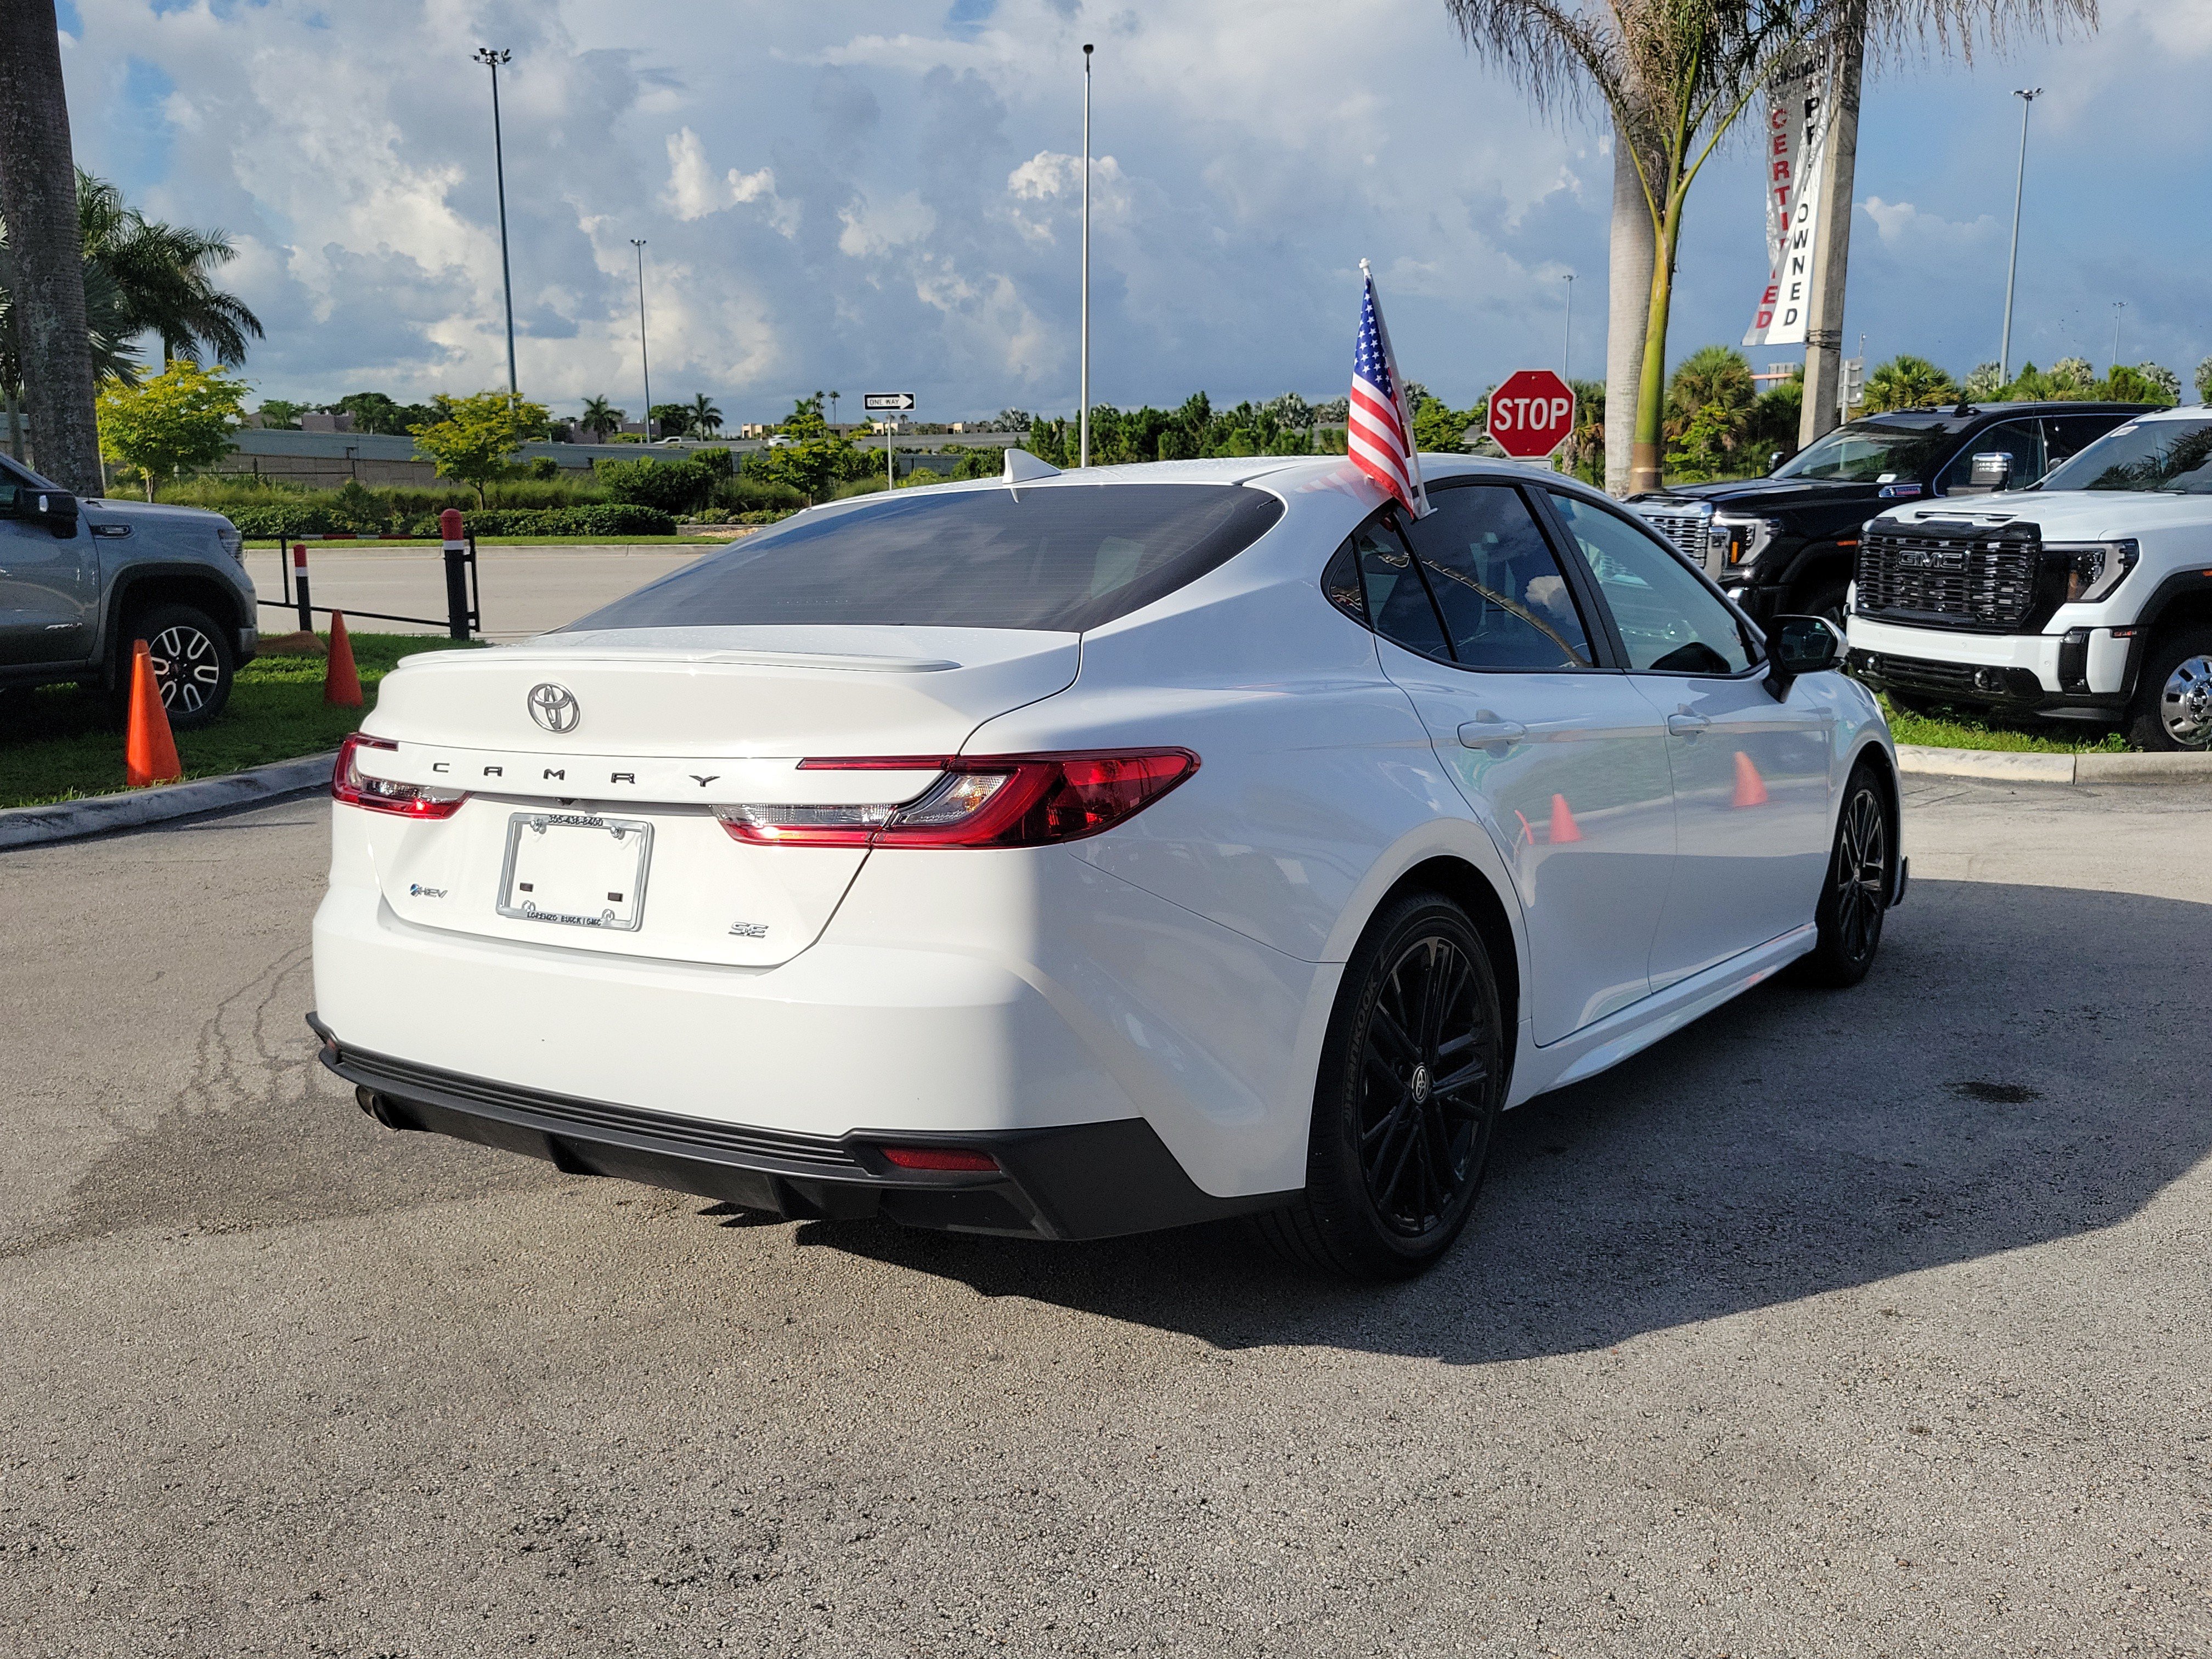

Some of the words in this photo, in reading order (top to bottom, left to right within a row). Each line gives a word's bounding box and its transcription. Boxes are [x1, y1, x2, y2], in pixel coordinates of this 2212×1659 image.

[1494, 398, 1569, 431] STOP
[1899, 550, 1963, 569] GMC
[432, 762, 721, 787] CAMRY
[561, 915, 582, 924] BUICK
[586, 918, 602, 927] GMC
[728, 922, 769, 939] SE
